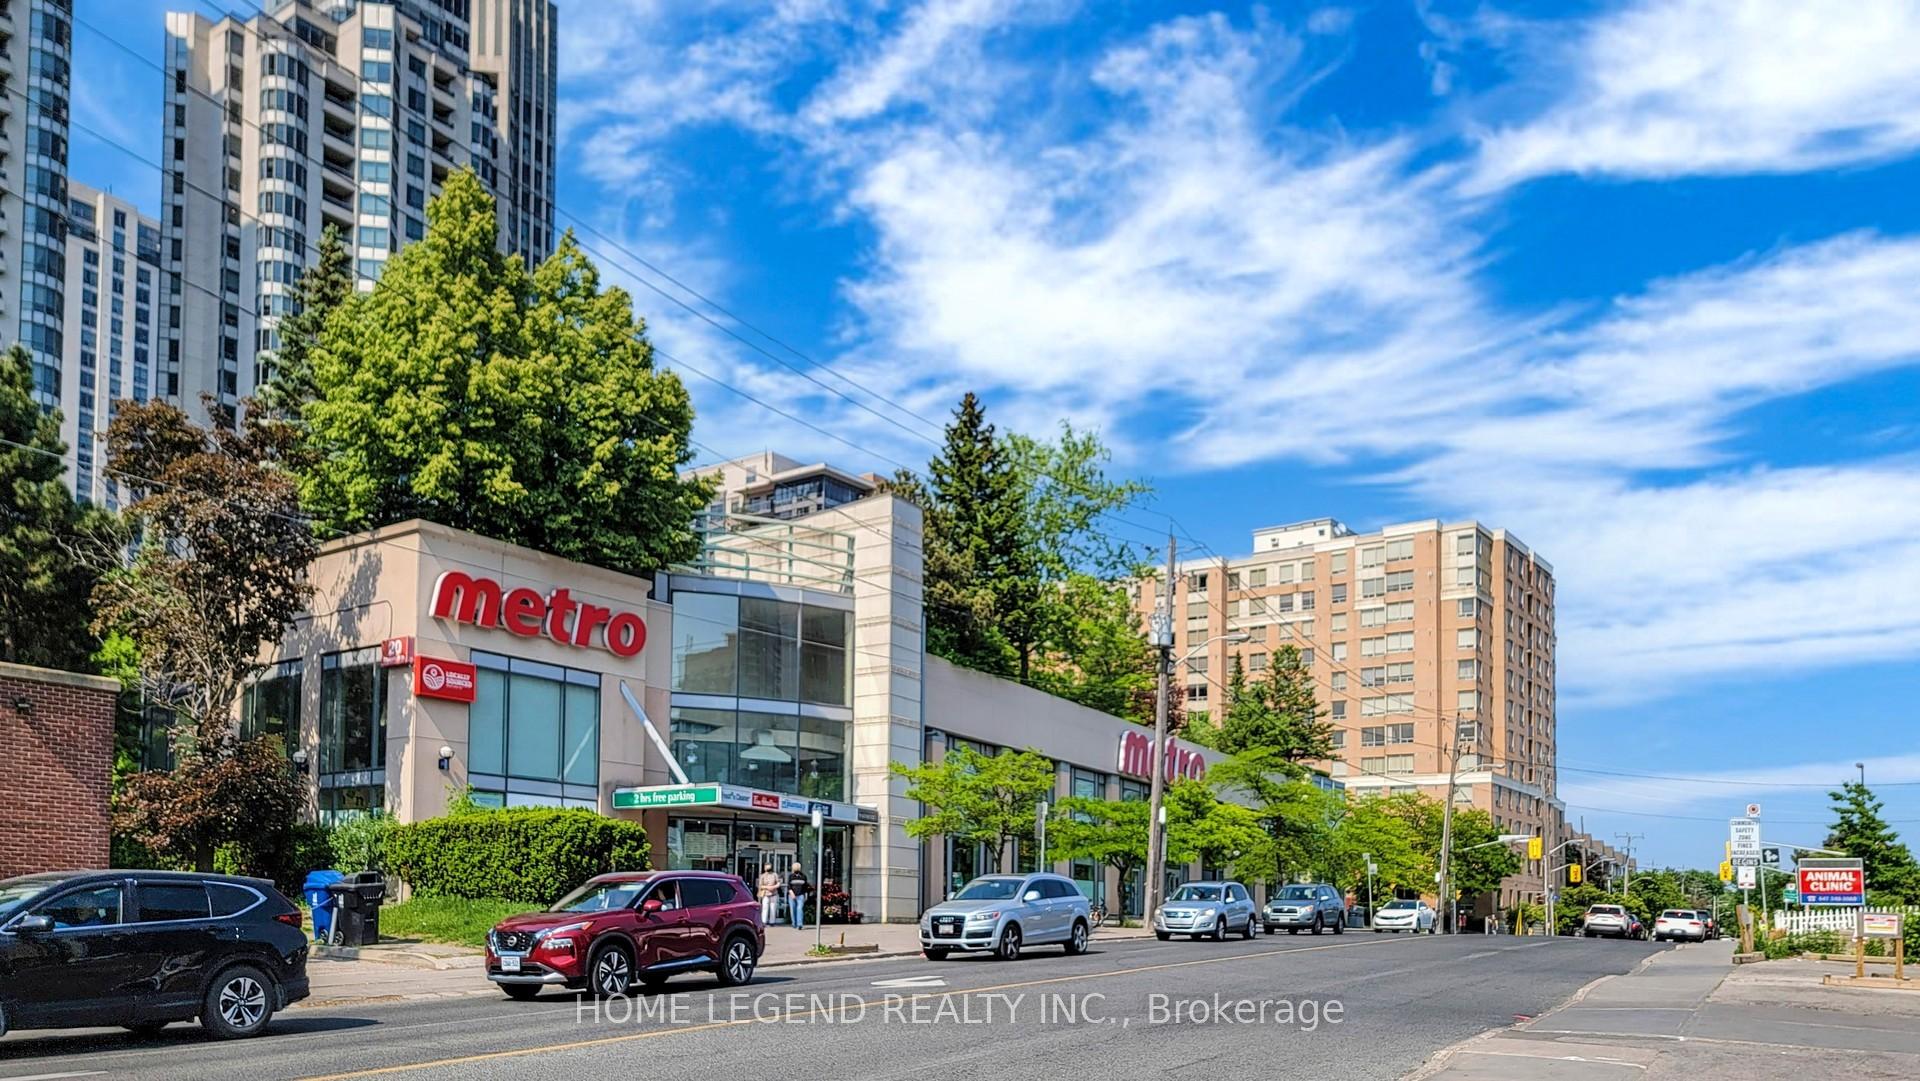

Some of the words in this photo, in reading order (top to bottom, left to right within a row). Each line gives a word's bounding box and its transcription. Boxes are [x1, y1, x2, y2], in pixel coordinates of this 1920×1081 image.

[429, 571, 647, 657] metro
[1119, 730, 1205, 782] mtro
[633, 793, 640, 804] 2
[641, 794, 652, 803] hrs
[653, 792, 667, 802] free
[668, 791, 695, 804] parking
[1805, 872, 1857, 882] ANIMAL
[1810, 881, 1854, 892] CLINIC
